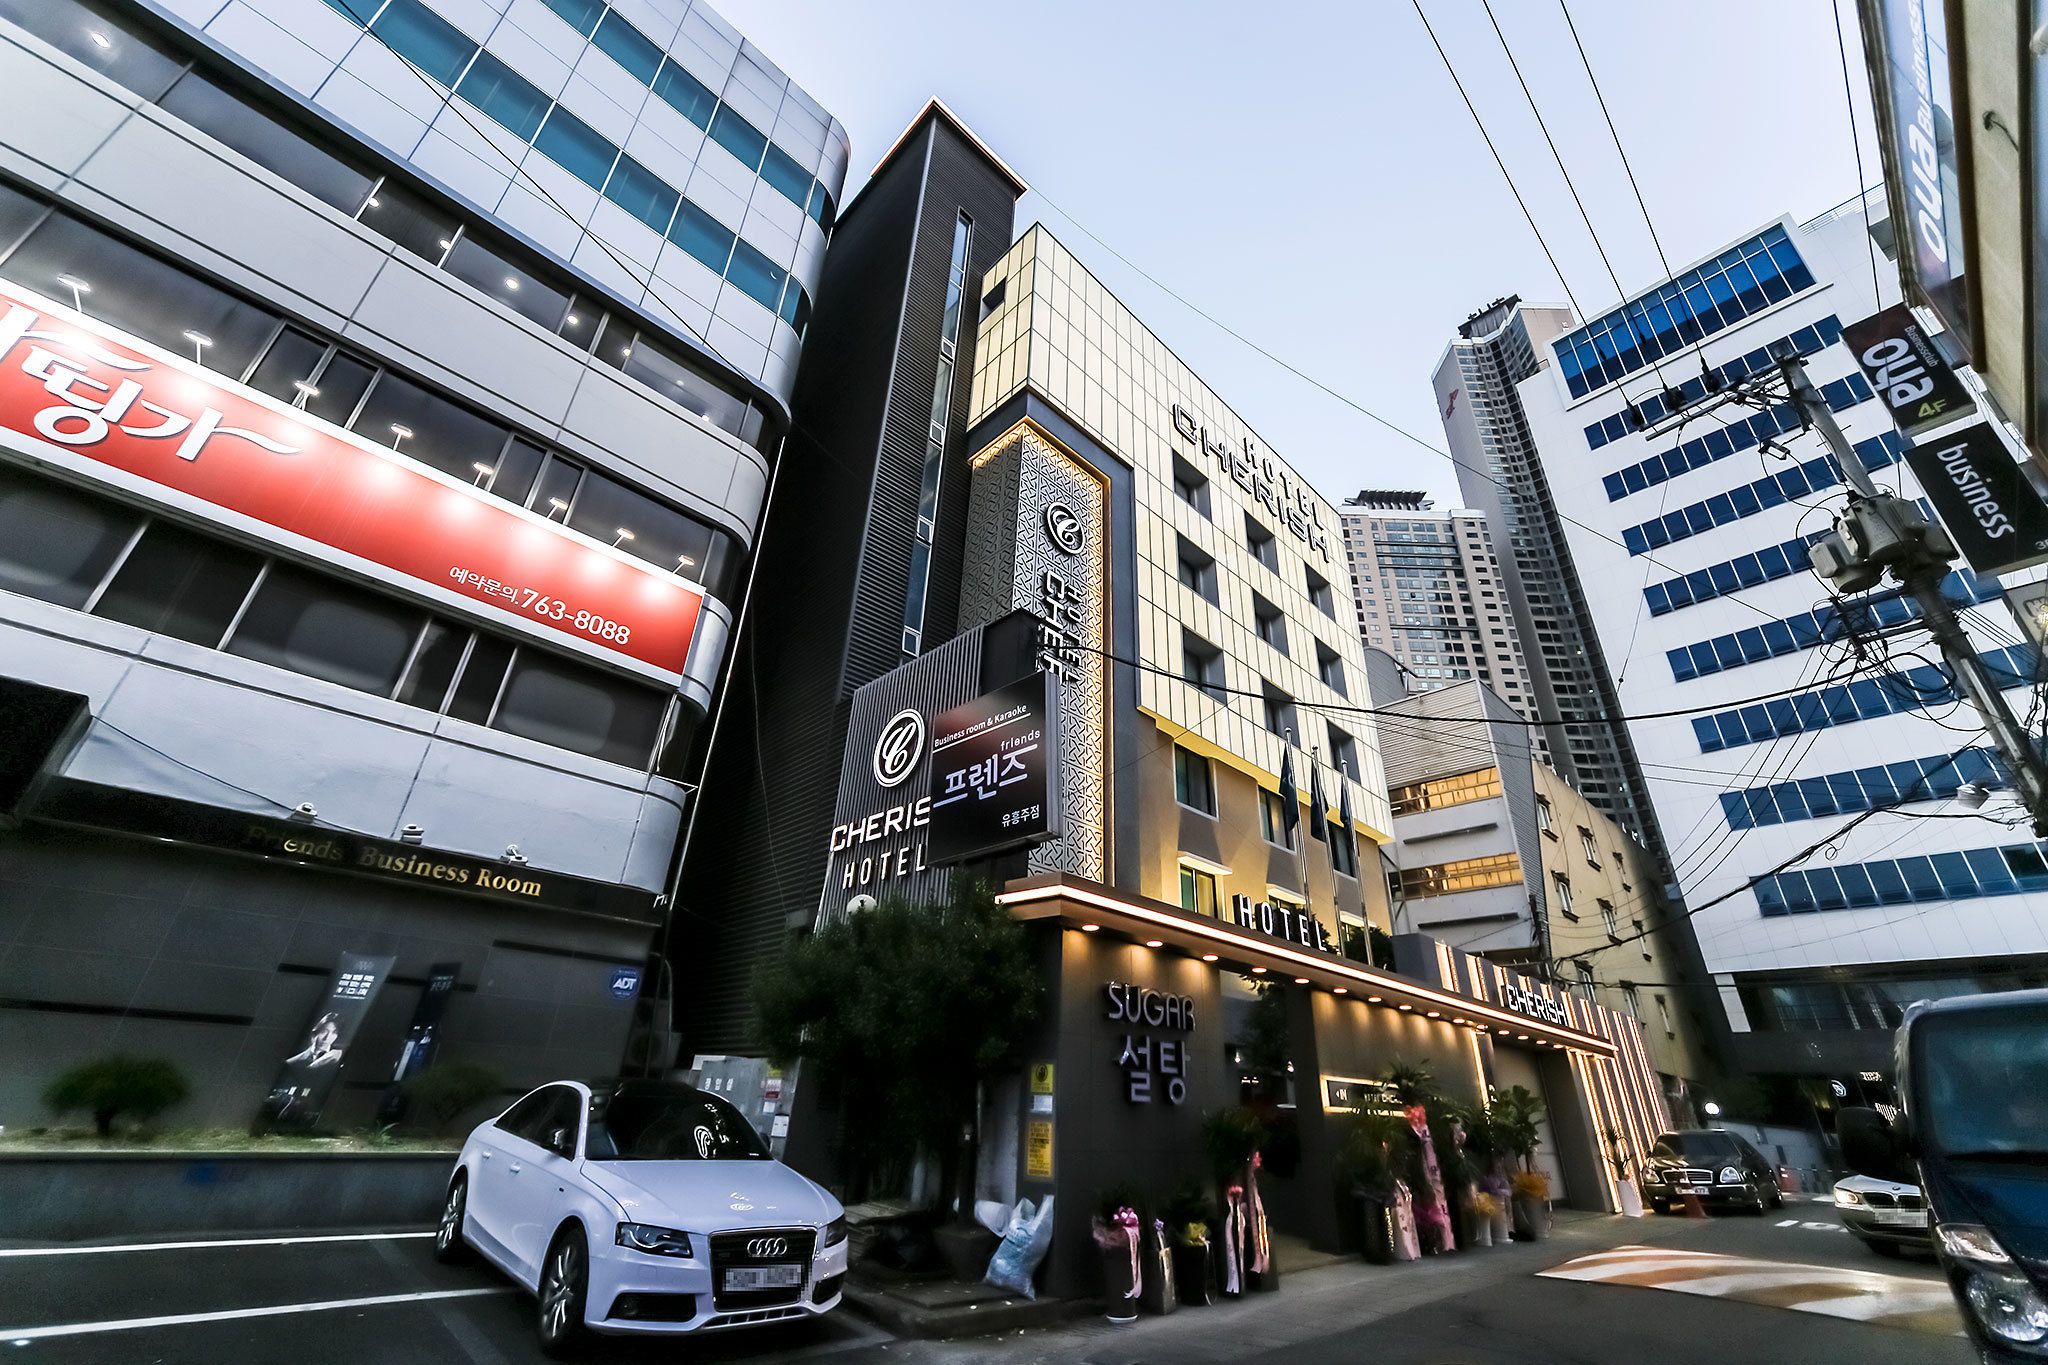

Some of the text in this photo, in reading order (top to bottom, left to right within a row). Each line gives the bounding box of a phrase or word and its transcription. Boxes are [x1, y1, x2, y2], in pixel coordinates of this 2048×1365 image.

[1917, 399, 1948, 418] 4F
[1173, 402, 1330, 563] CHERISH
[1243, 437, 1324, 531] HOTEL
[1936, 443, 2015, 540] business
[521, 587, 632, 646] 763-8088
[1066, 585, 1083, 682] HOTEL
[934, 704, 1027, 748] Business room & Karaoke
[1000, 729, 1041, 752] friends
[932, 743, 1039, 809] 프렌즈
[1001, 804, 1041, 828] 유흥주점
[359, 845, 470, 884] Business
[475, 867, 542, 898] Room
[843, 843, 926, 890] HOTEL
[1237, 892, 1328, 952] HOTEL
[612, 977, 637, 990] ADT
[1107, 980, 1197, 1032] SUGAR
[1506, 984, 1568, 1027] CHERISH
[1118, 1034, 1192, 1106] 설탕
